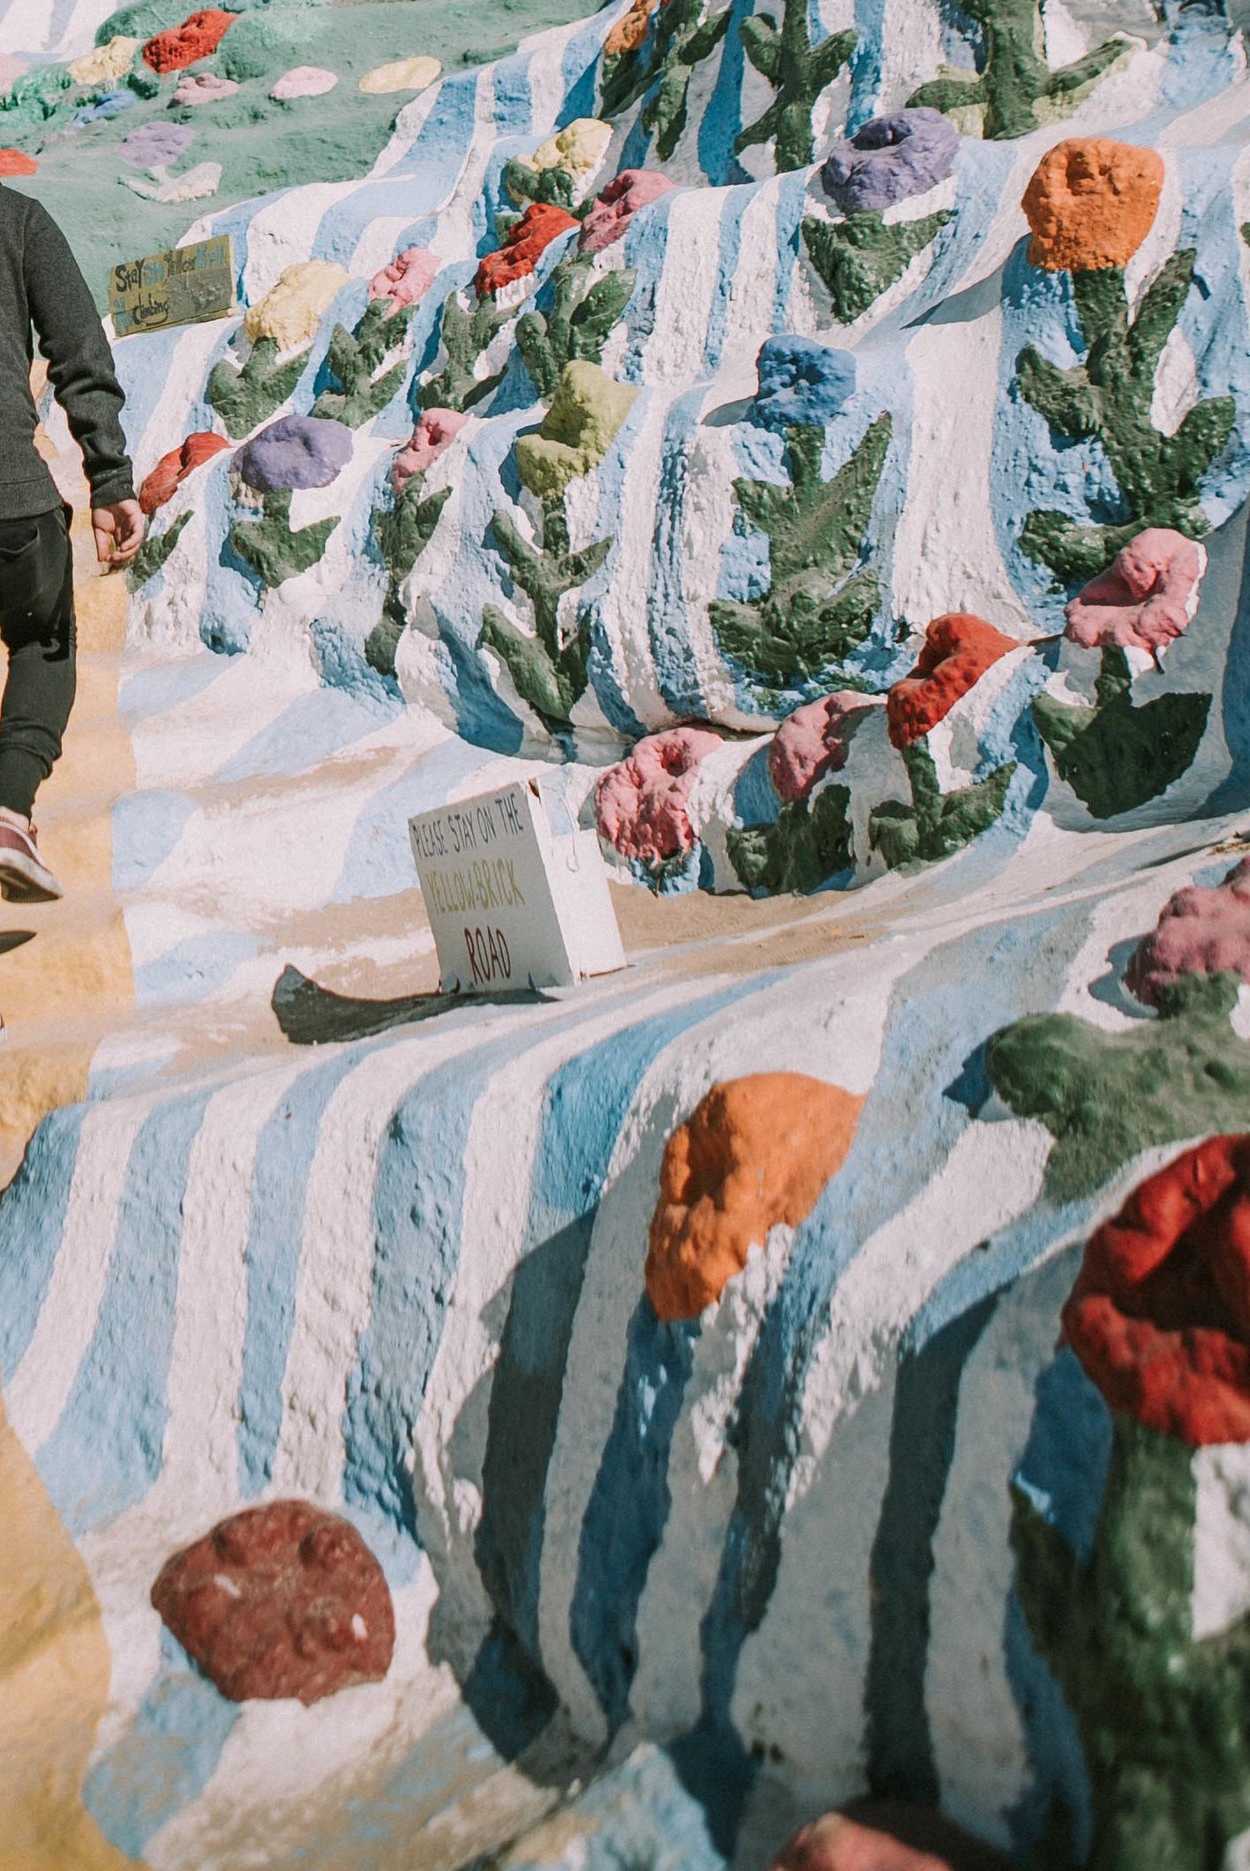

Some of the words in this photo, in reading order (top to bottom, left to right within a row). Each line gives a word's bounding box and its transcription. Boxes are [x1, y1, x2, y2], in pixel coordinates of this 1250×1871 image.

[413, 820, 448, 858] PLEASE
[447, 811, 477, 853] STAY
[476, 805, 497, 844] ON
[495, 793, 524, 836] THE
[463, 926, 512, 985] ROAD
